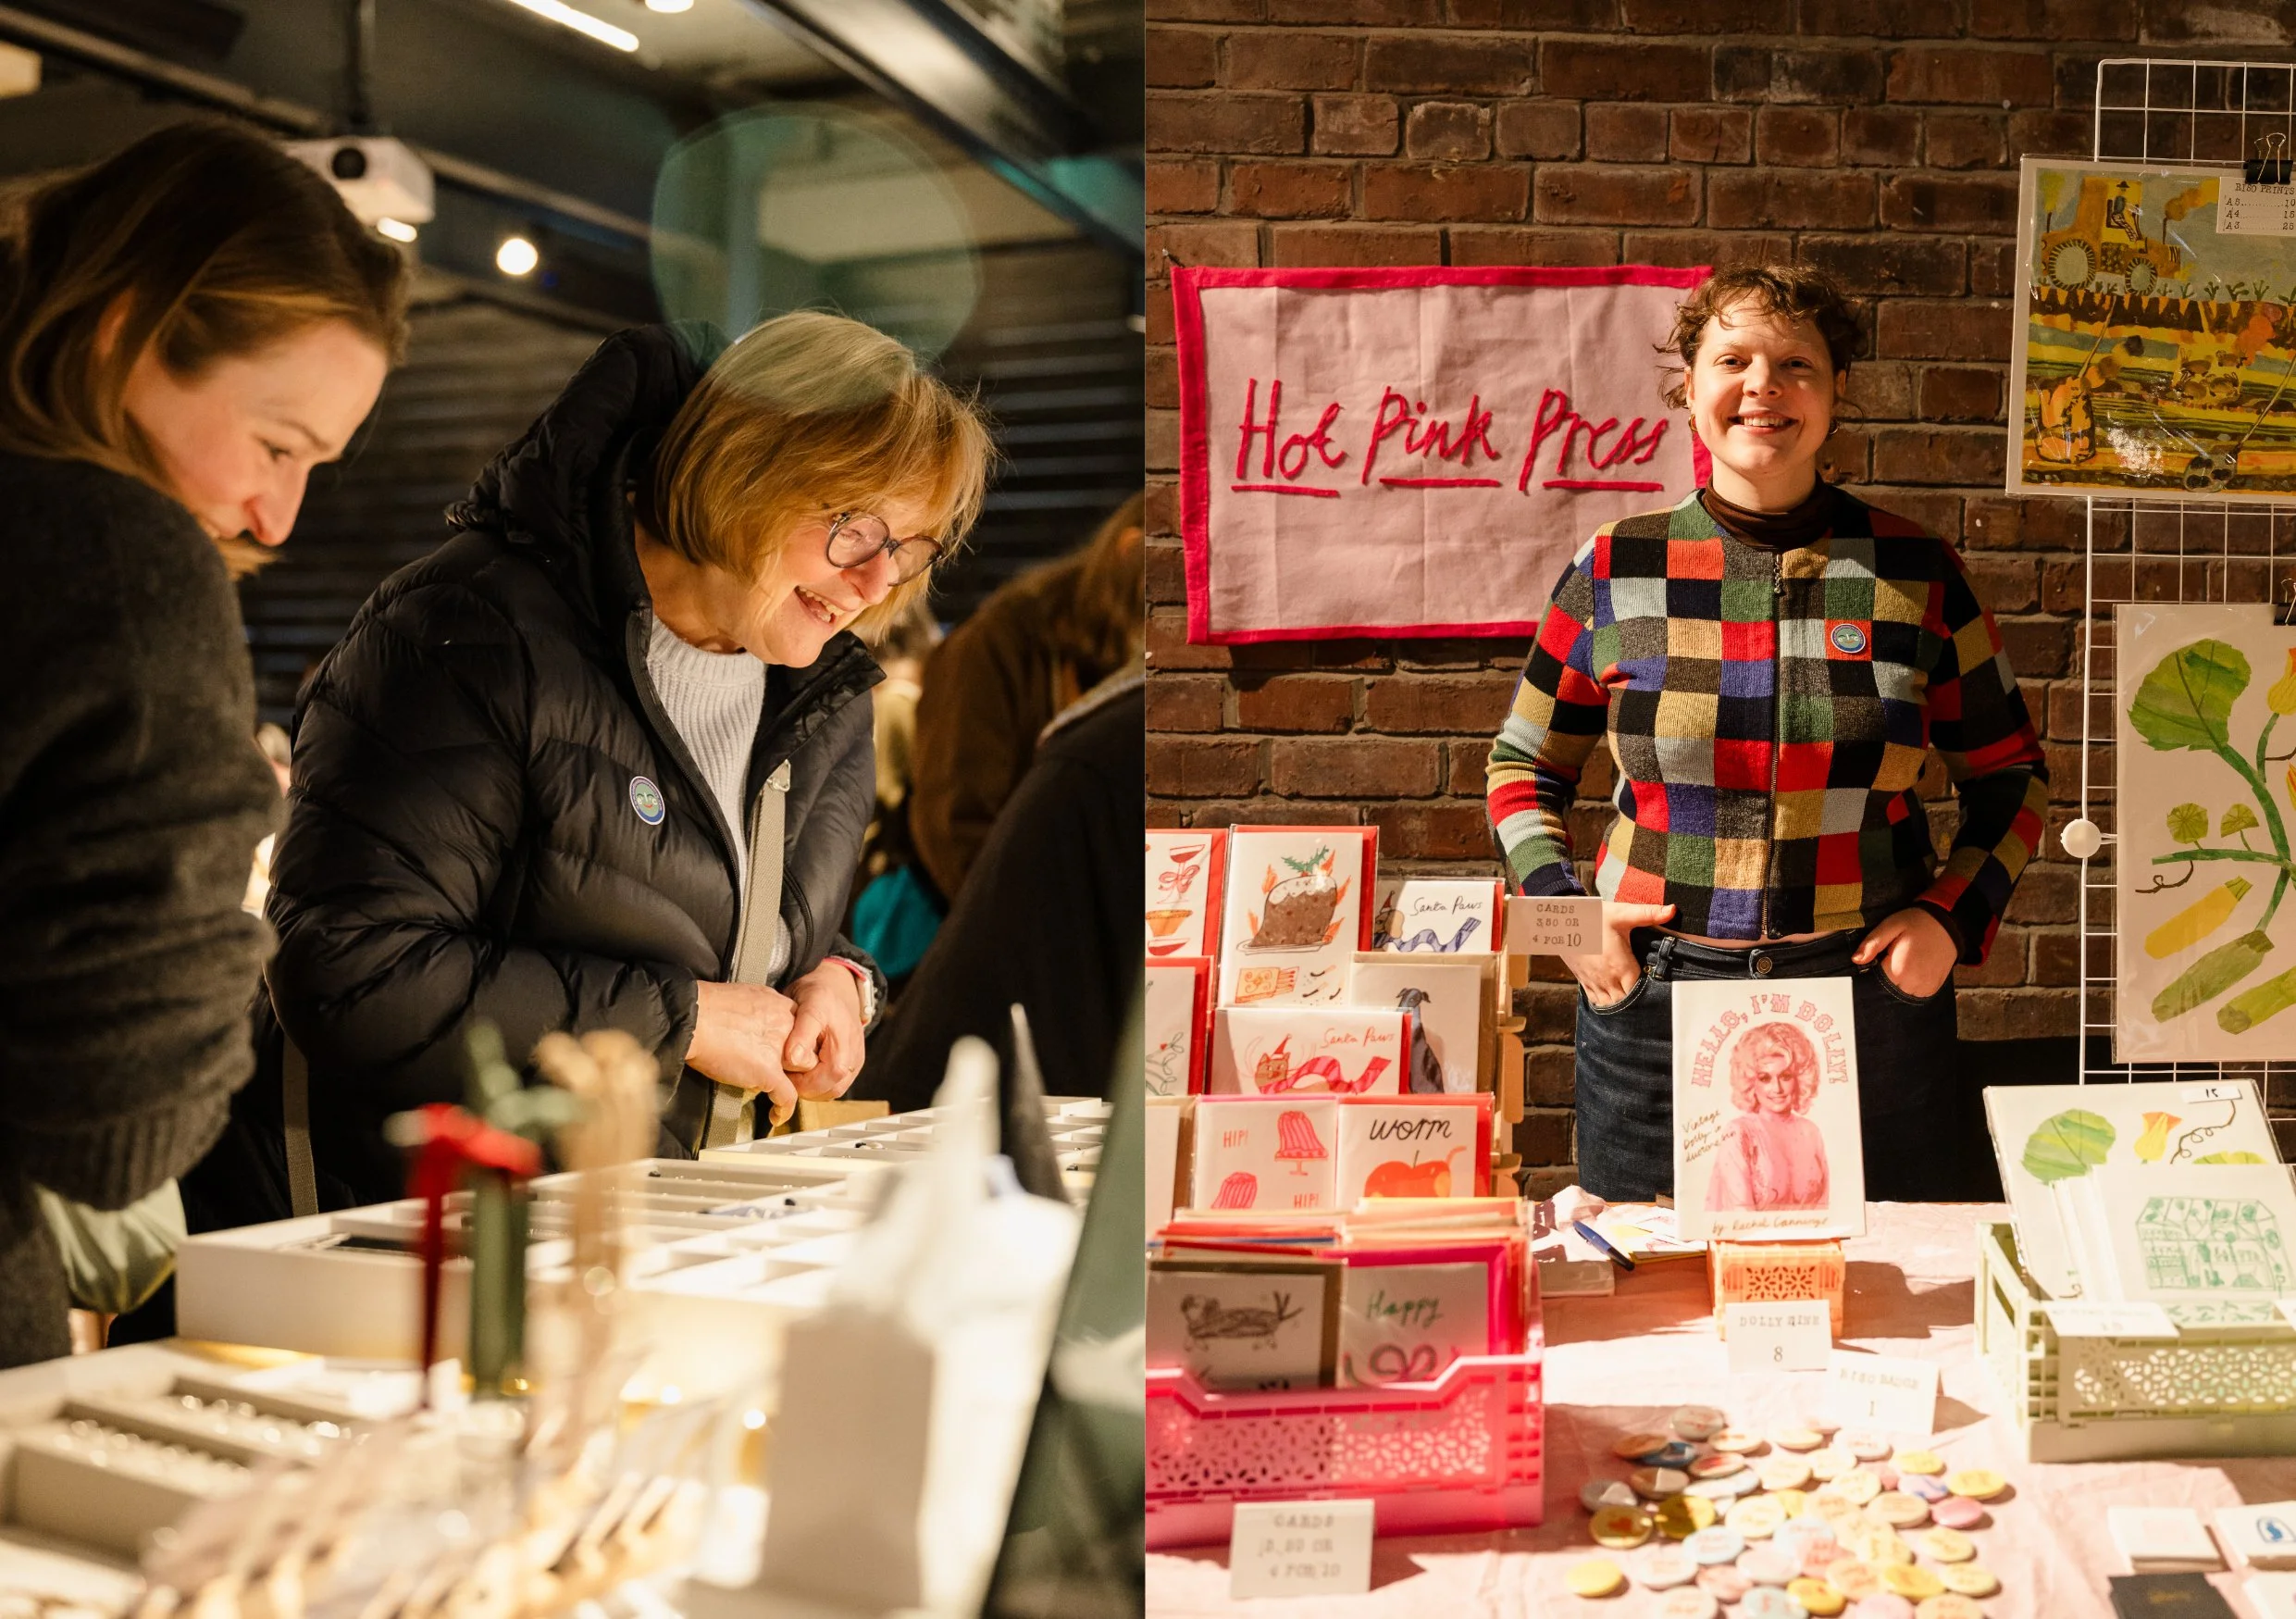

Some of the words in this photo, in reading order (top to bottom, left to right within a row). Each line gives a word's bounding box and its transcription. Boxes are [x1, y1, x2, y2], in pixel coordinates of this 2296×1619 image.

[2260, 185, 2295, 194] PRINTS
[2226, 210, 2240, 218] A4
[1236, 379, 1347, 479] Hot
[1361, 386, 1501, 486] Pink
[1519, 388, 1669, 492] Press
[1409, 897, 1447, 916] Santa
[1452, 895, 1483, 915] Paws
[1536, 903, 1575, 914] CARDS
[1545, 937, 1565, 945] FOR
[1567, 933, 1582, 947] 10
[1321, 1027, 1358, 1048] Santa
[1363, 1027, 1395, 1047] Paws
[1692, 1010, 1748, 1088] HELLO,
[1750, 993, 1791, 1015] I'M
[1370, 1118, 1452, 1140] worm
[1223, 1130, 1248, 1148] HIP!
[1294, 1193, 1319, 1208] HIP!
[1712, 1219, 1726, 1236] by
[1368, 1290, 1442, 1328] Happy
[1740, 1315, 1782, 1327] DOLLY
[1773, 1346, 1783, 1363] 8
